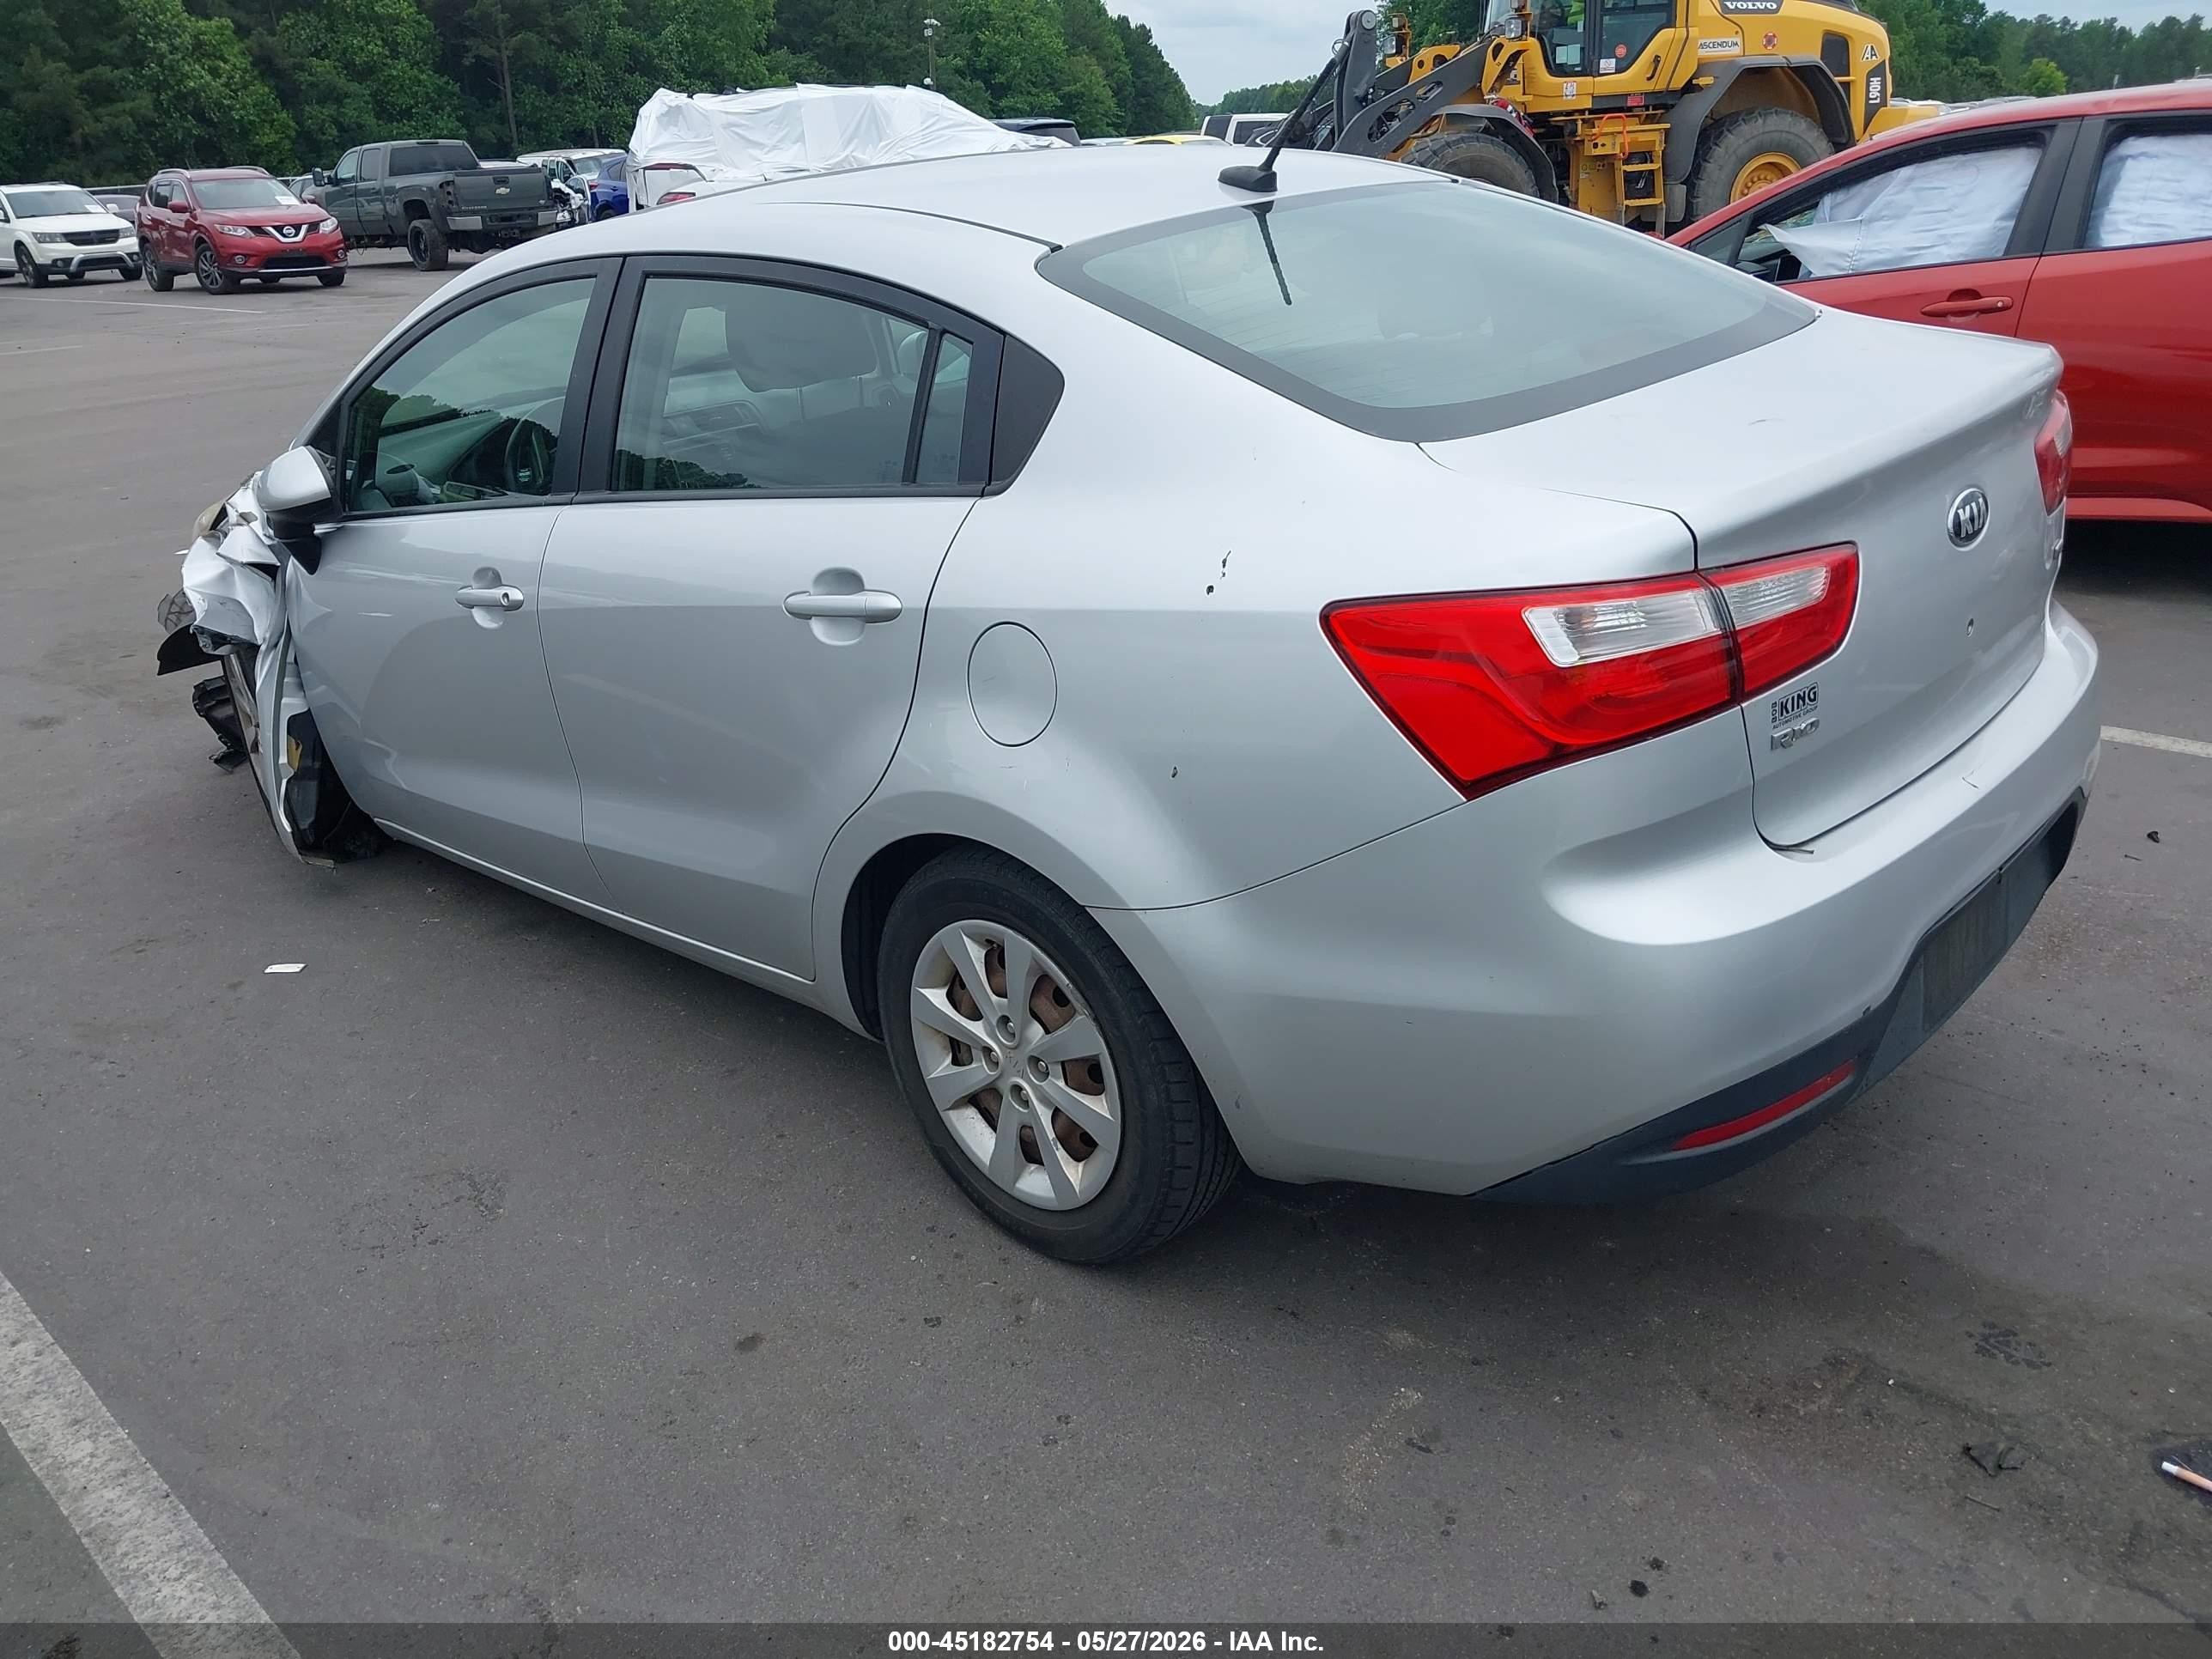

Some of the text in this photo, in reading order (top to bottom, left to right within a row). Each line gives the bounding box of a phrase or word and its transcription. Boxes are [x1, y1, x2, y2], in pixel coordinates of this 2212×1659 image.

[1698, 40, 1740, 49] ASCENDUM
[1869, 76, 1882, 104] L90H
[1957, 497, 1988, 538] KIA
[1780, 685, 1817, 717] KING
[1772, 712, 1802, 729] AUTOMOTIVE
